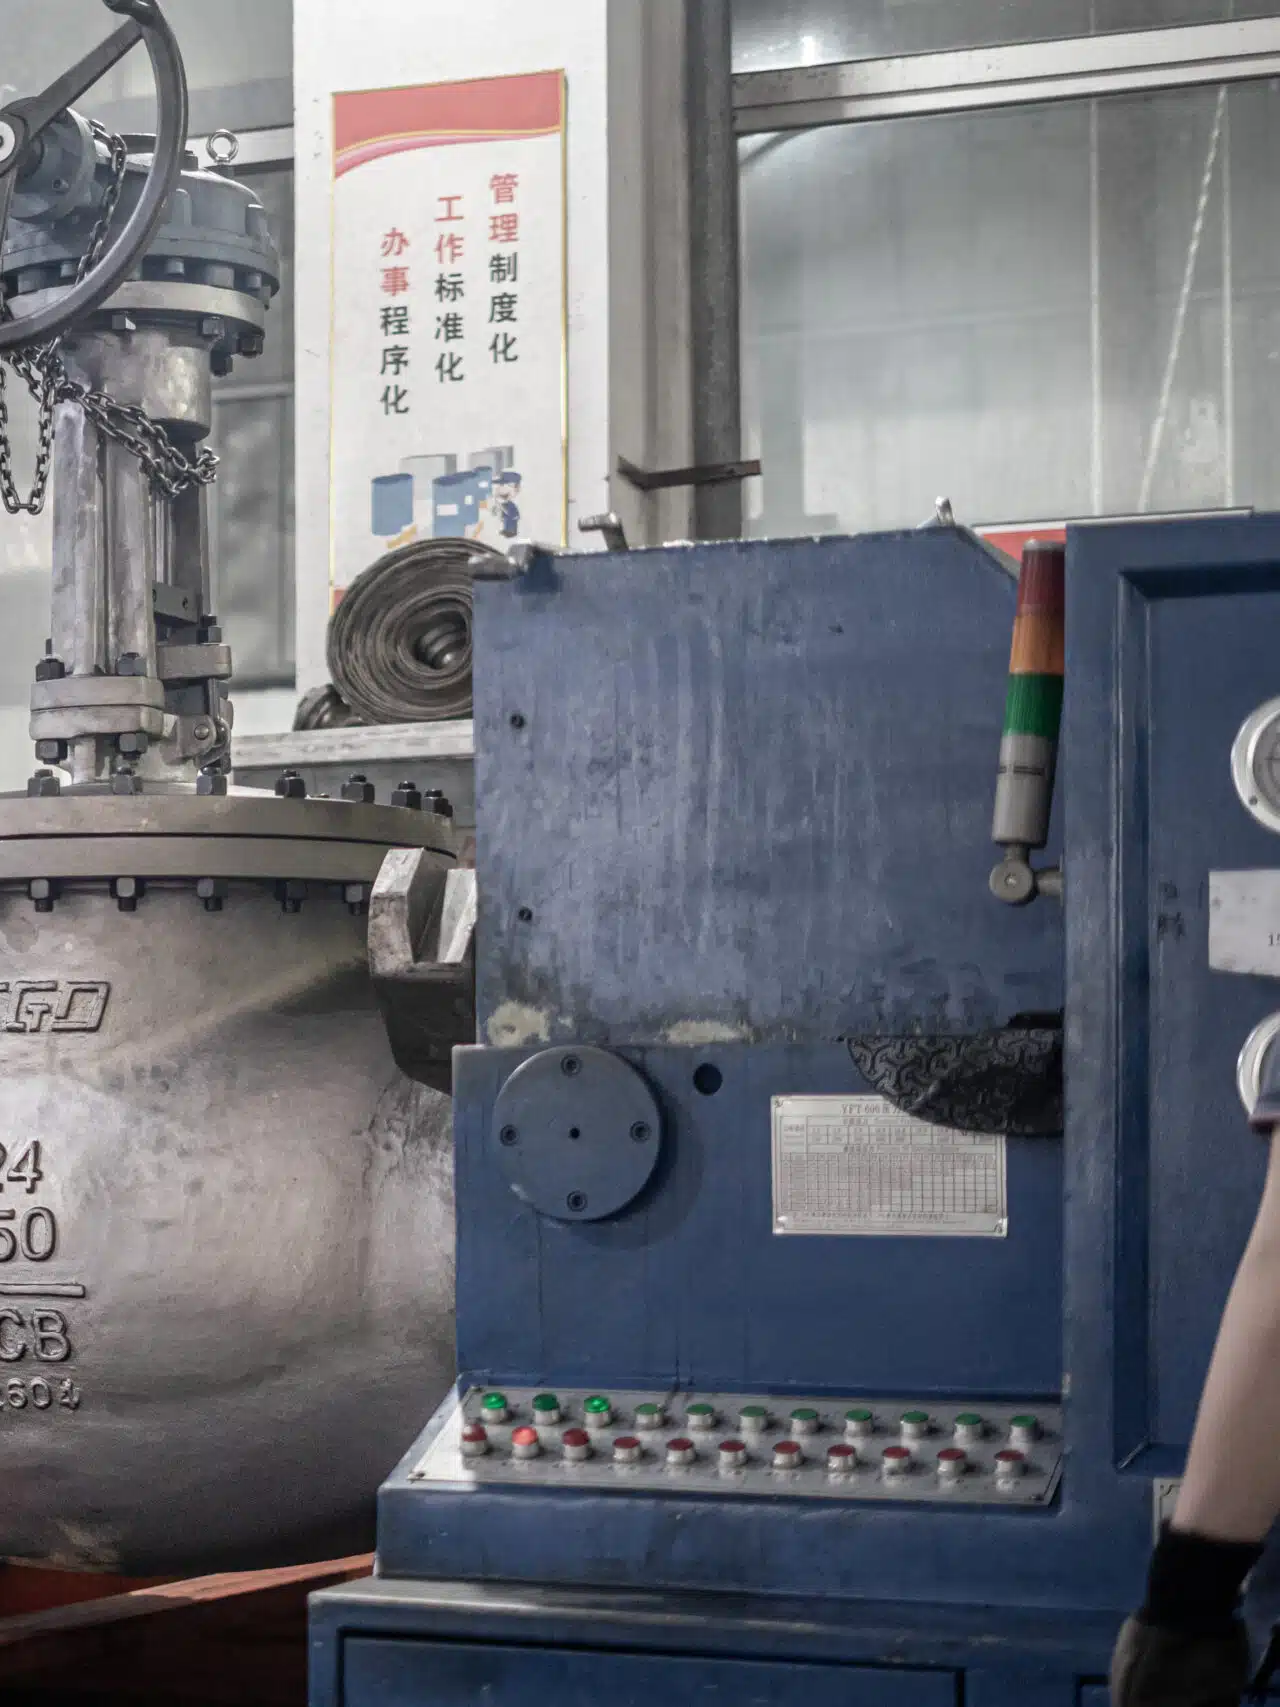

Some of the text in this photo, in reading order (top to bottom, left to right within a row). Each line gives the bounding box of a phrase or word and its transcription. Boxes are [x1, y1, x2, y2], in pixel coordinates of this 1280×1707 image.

[379, 226, 411, 416] 办事程序化
[433, 194, 466, 384] 工作标准化
[488, 172, 520, 364] 管理制度化
